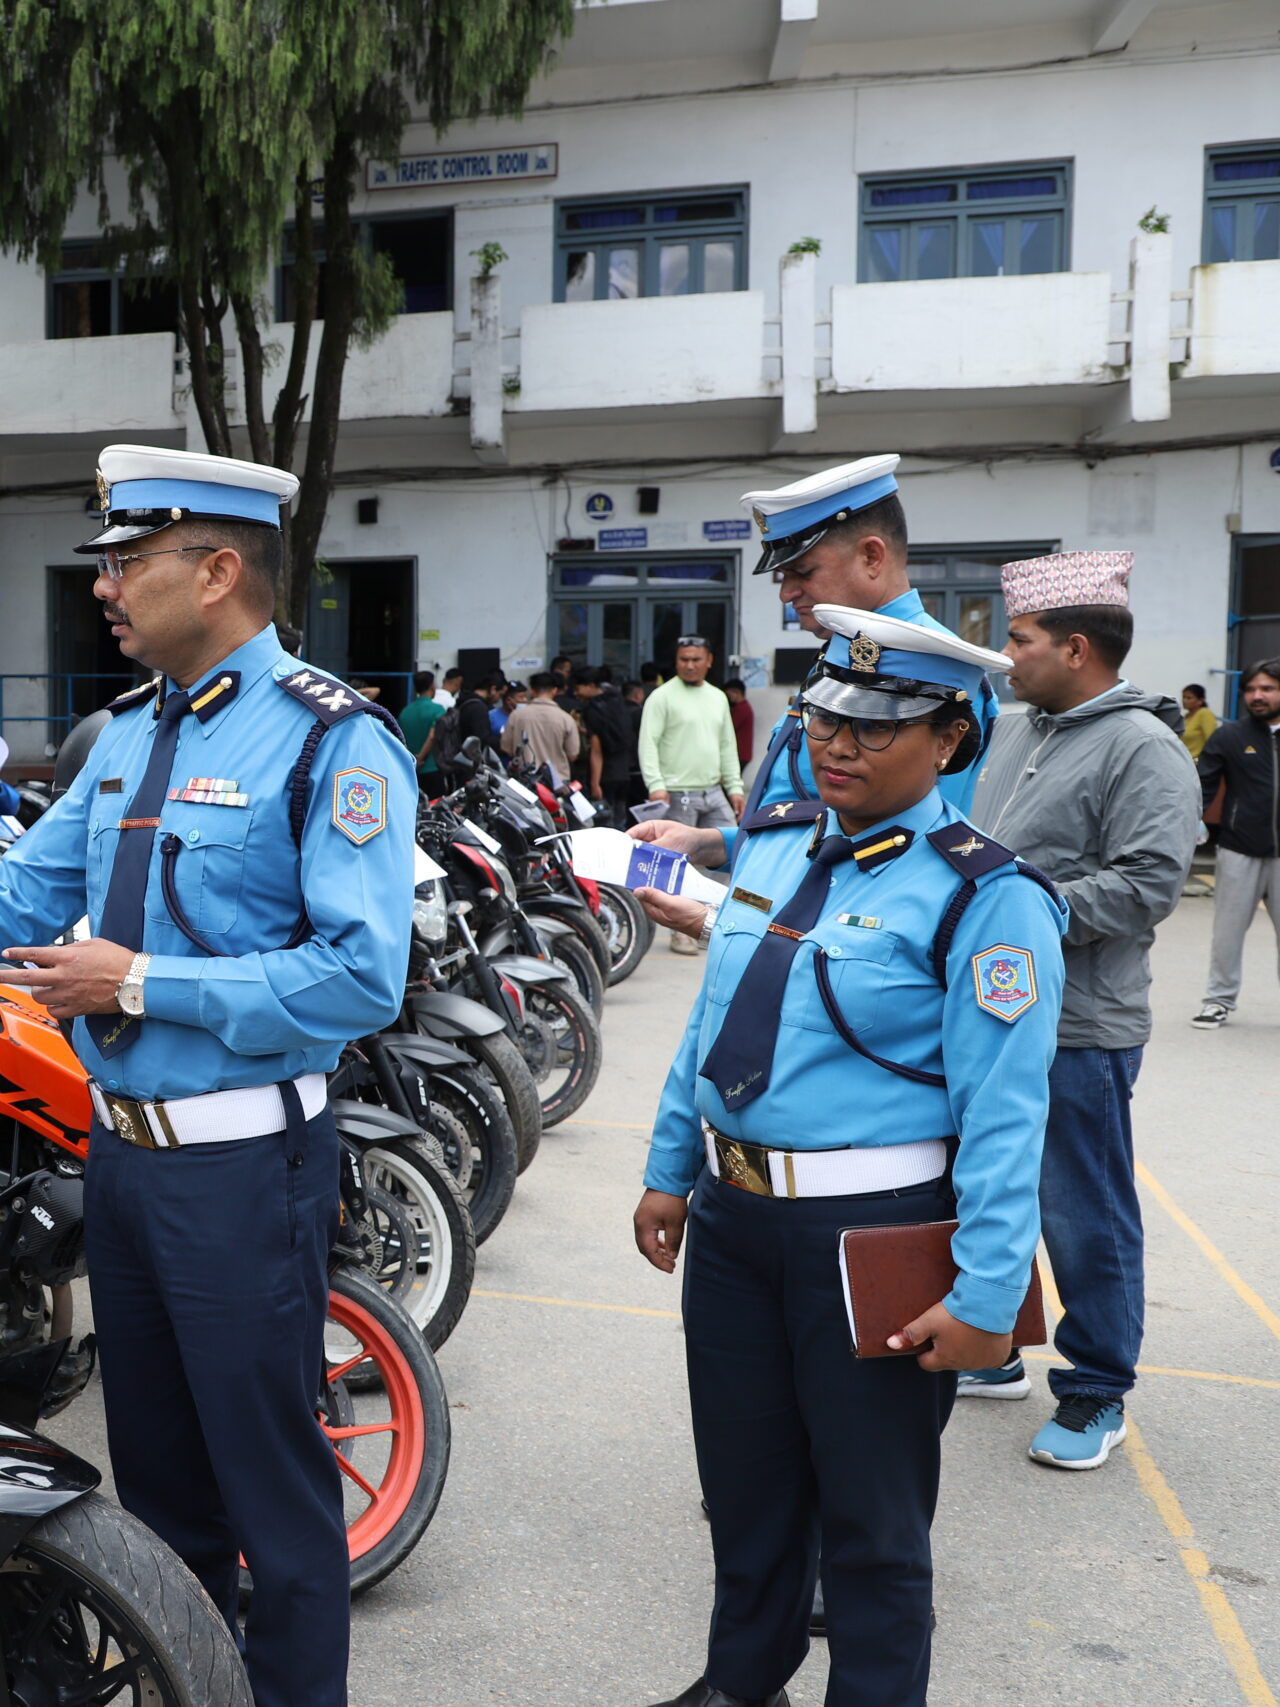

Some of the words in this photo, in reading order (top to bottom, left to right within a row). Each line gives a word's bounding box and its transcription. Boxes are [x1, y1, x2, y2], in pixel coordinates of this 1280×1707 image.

[395, 158, 439, 183] TRAFFIC
[442, 154, 493, 179] CONTROL
[496, 152, 529, 174] ROOM
[416, 1076, 428, 1107] ABS
[30, 1205, 56, 1231] KTM
